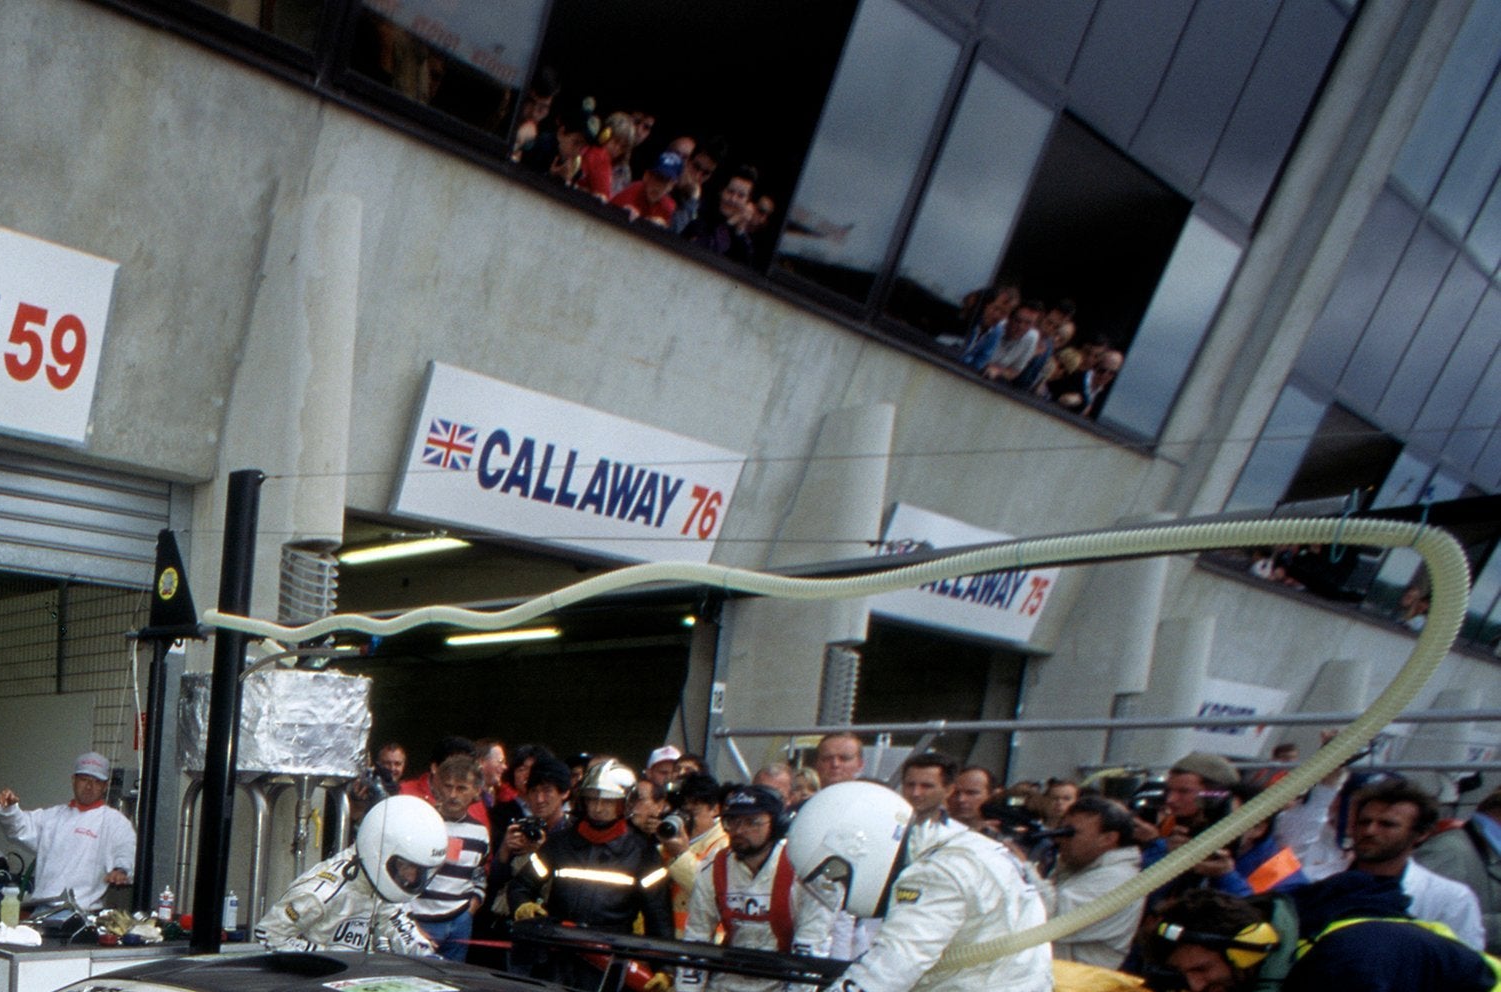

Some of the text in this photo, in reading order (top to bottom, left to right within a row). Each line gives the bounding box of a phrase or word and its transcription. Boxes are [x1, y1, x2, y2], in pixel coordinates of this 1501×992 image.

[3, 301, 87, 390] 59
[477, 428, 722, 539] CALLAWAY 76
[1018, 575, 1050, 617] 75
